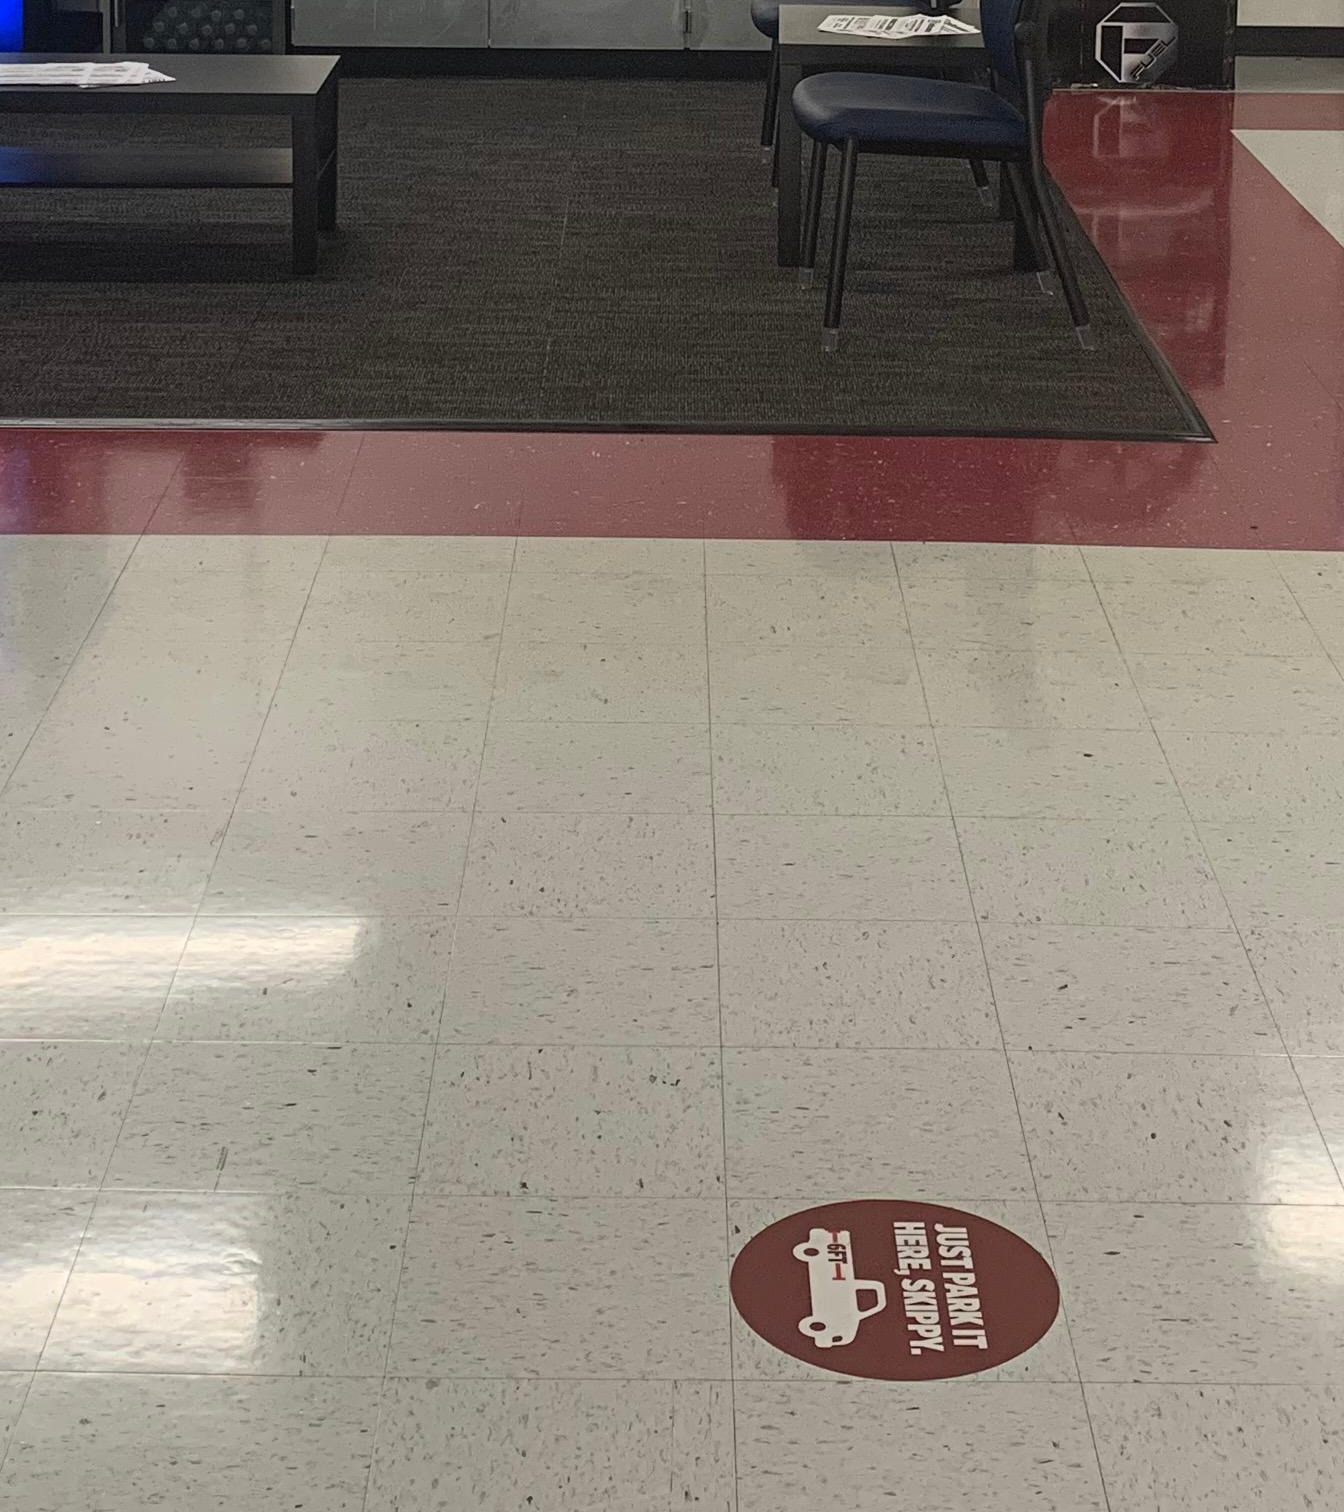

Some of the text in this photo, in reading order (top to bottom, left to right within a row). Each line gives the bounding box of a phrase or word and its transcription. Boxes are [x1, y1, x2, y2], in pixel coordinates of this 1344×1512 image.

[1130, 36, 1177, 81] FUEL
[826, 1243, 847, 1265] 6FT
[893, 1221, 945, 1356] HERE, SKIPPY.
[934, 1223, 988, 1350] JUST PARK IT
